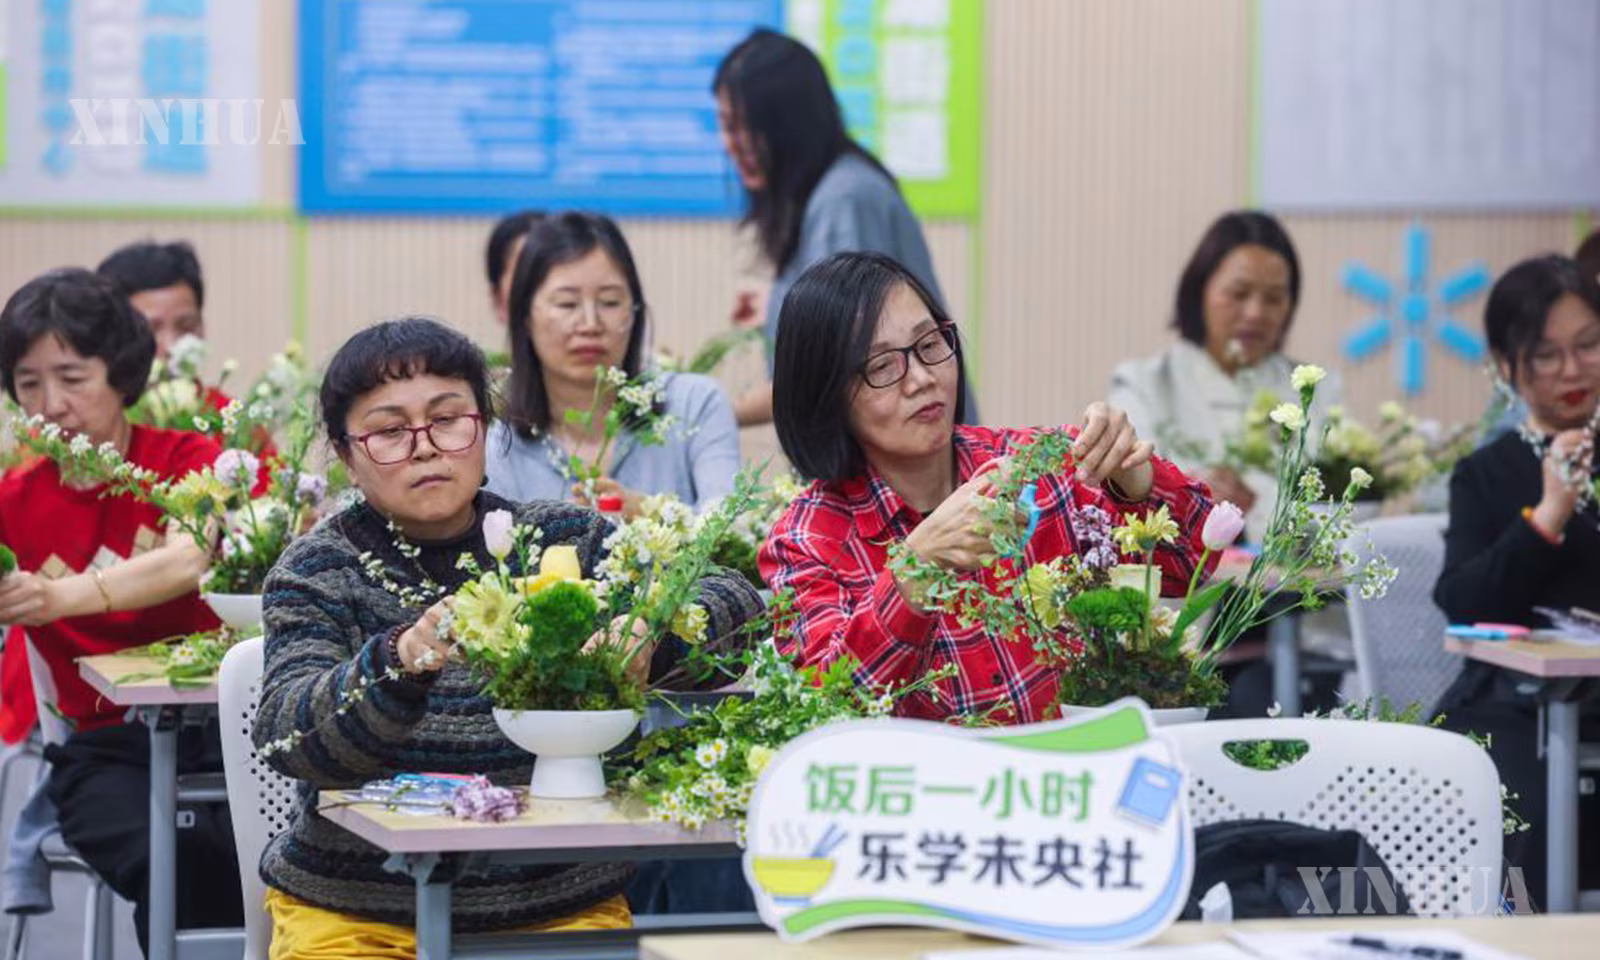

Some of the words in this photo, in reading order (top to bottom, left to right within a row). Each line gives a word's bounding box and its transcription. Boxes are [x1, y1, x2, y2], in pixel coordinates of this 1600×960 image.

[806, 762, 1094, 822] 饭后一小时
[857, 832, 1143, 890] 乐学未央社
